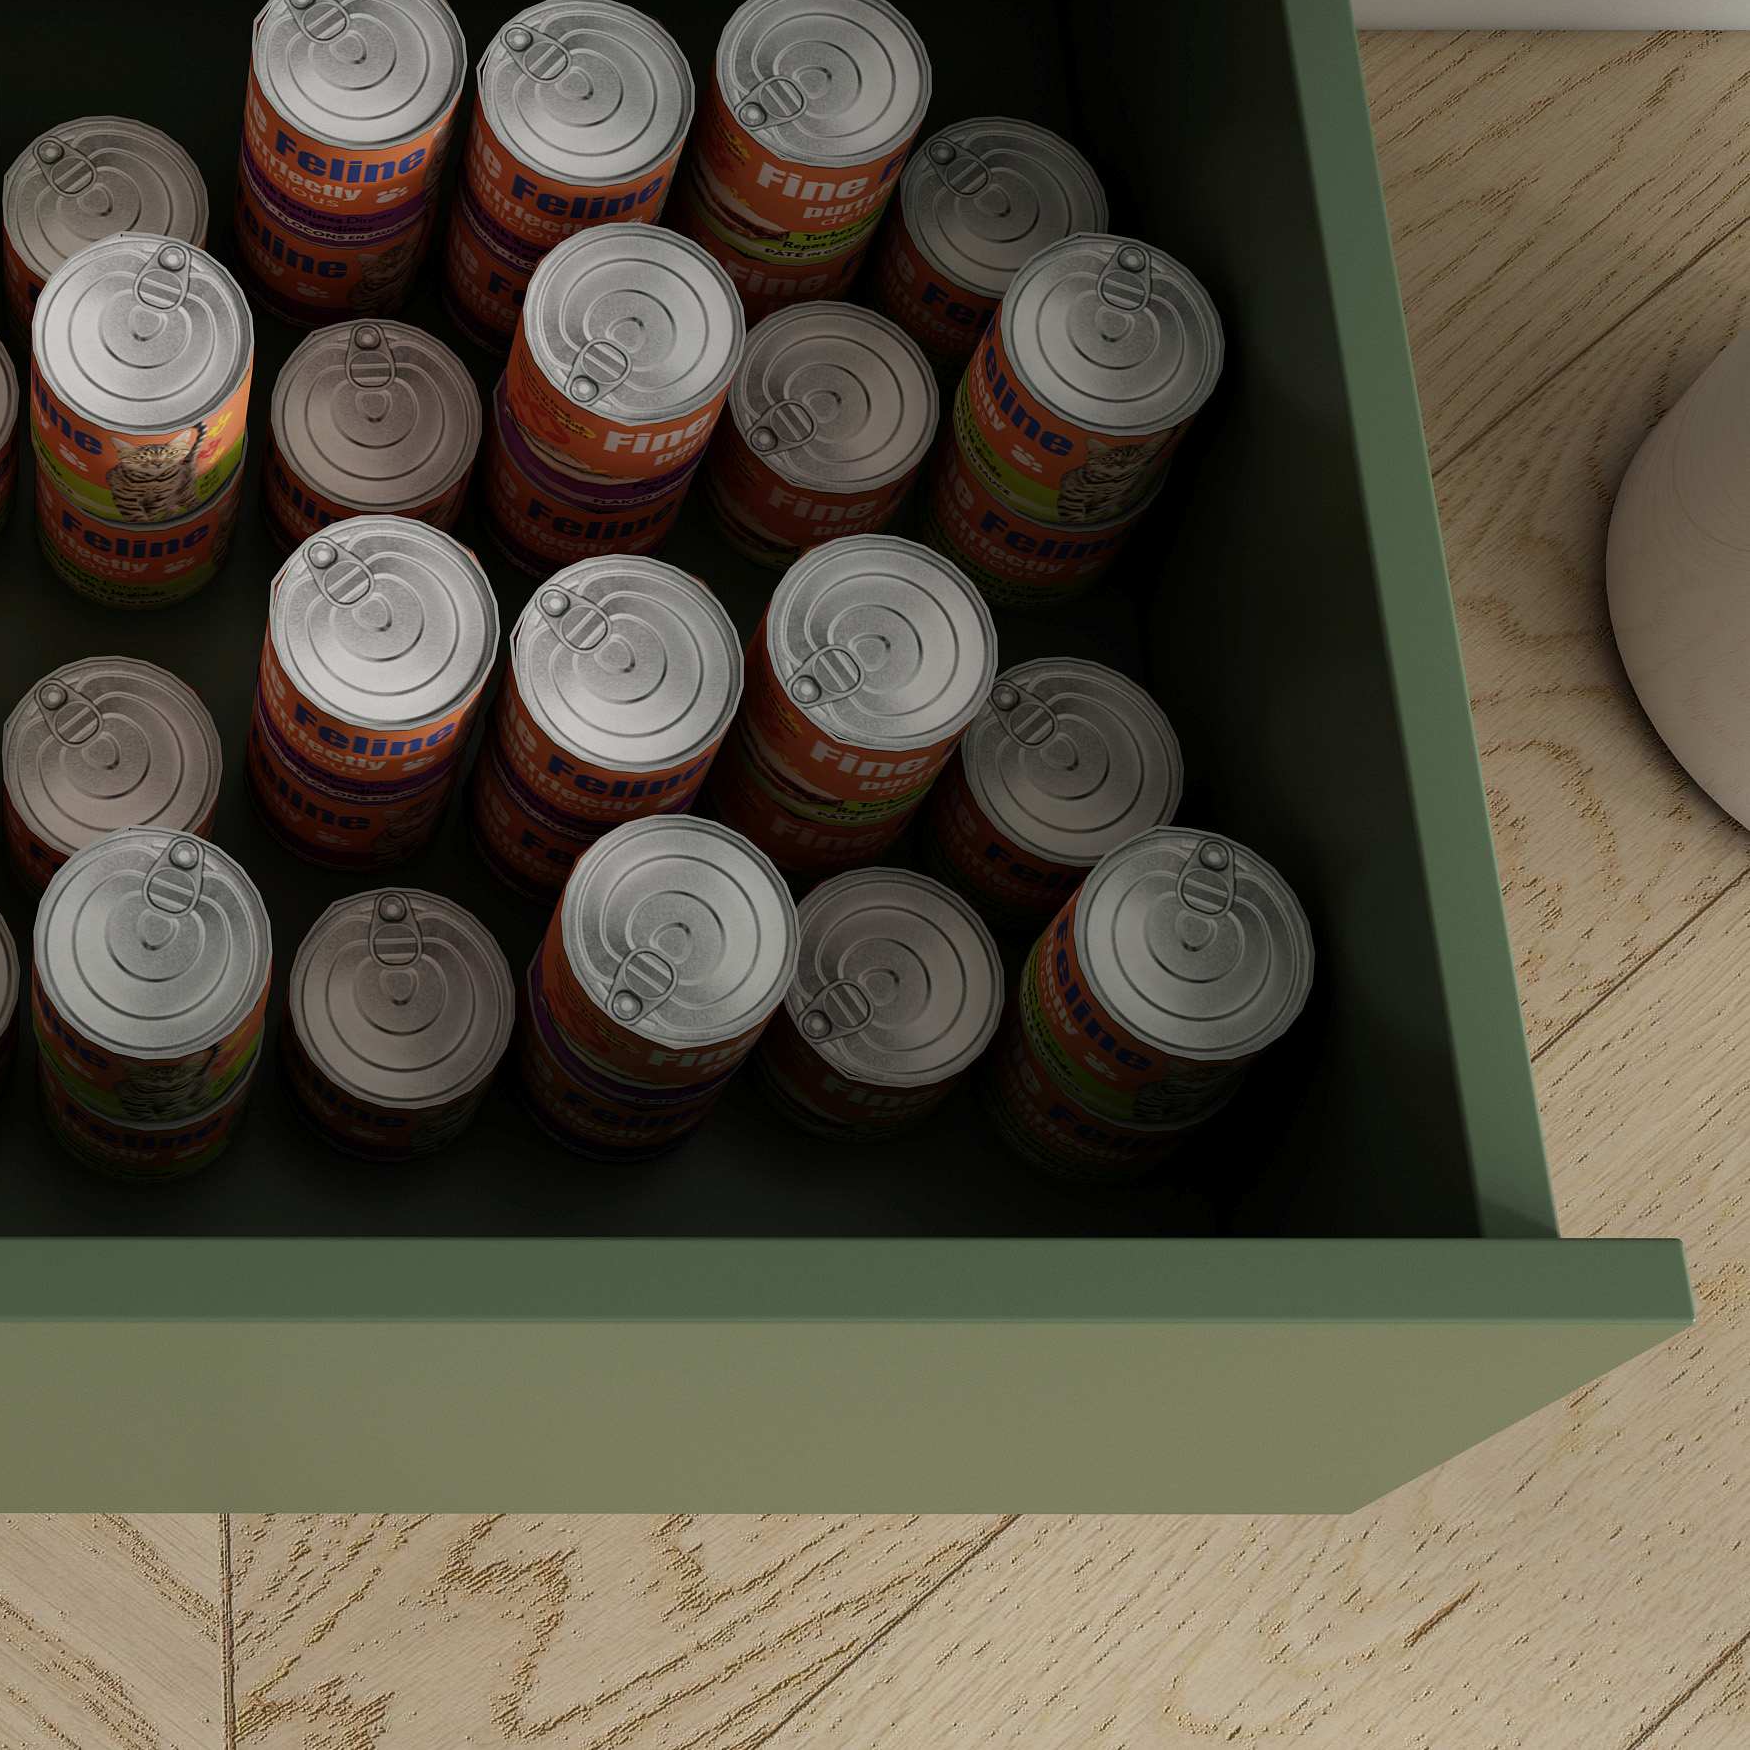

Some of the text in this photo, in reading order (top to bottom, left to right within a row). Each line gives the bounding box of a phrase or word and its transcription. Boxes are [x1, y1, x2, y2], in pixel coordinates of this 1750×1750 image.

[276, 129, 426, 183] Feline
[511, 173, 664, 219] Feline
[756, 161, 869, 202] Fine
[244, 204, 348, 279] eline
[726, 258, 829, 297] Fine
[603, 410, 712, 453] Fine
[768, 489, 877, 522] Fine
[296, 702, 458, 756] Feline
[810, 740, 930, 778] Fine
